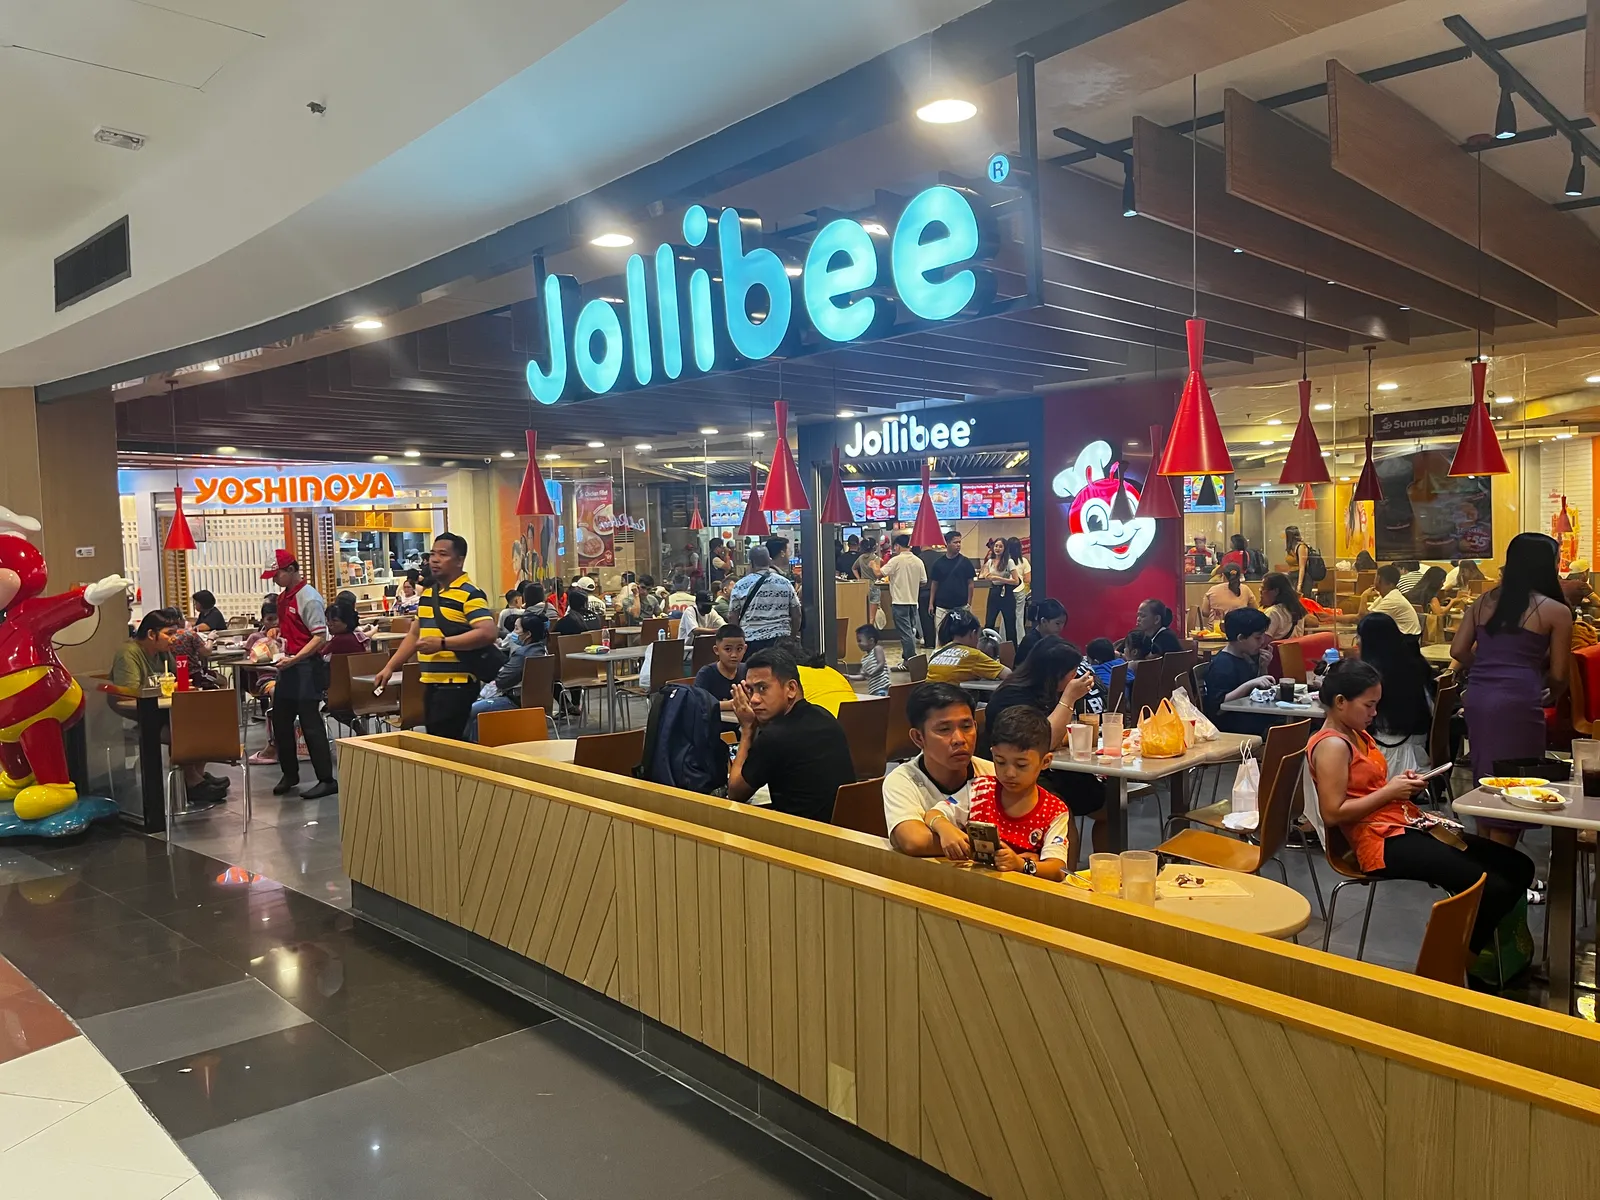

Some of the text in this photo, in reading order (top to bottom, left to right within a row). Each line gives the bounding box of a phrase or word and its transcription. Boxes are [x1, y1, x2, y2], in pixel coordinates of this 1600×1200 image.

[527, 186, 979, 405] Jollibee
[844, 413, 971, 458] Jollibee
[1393, 417, 1439, 429] Summer
[193, 472, 395, 505] YOSHINOYA
[176, 660, 188, 668] 37
